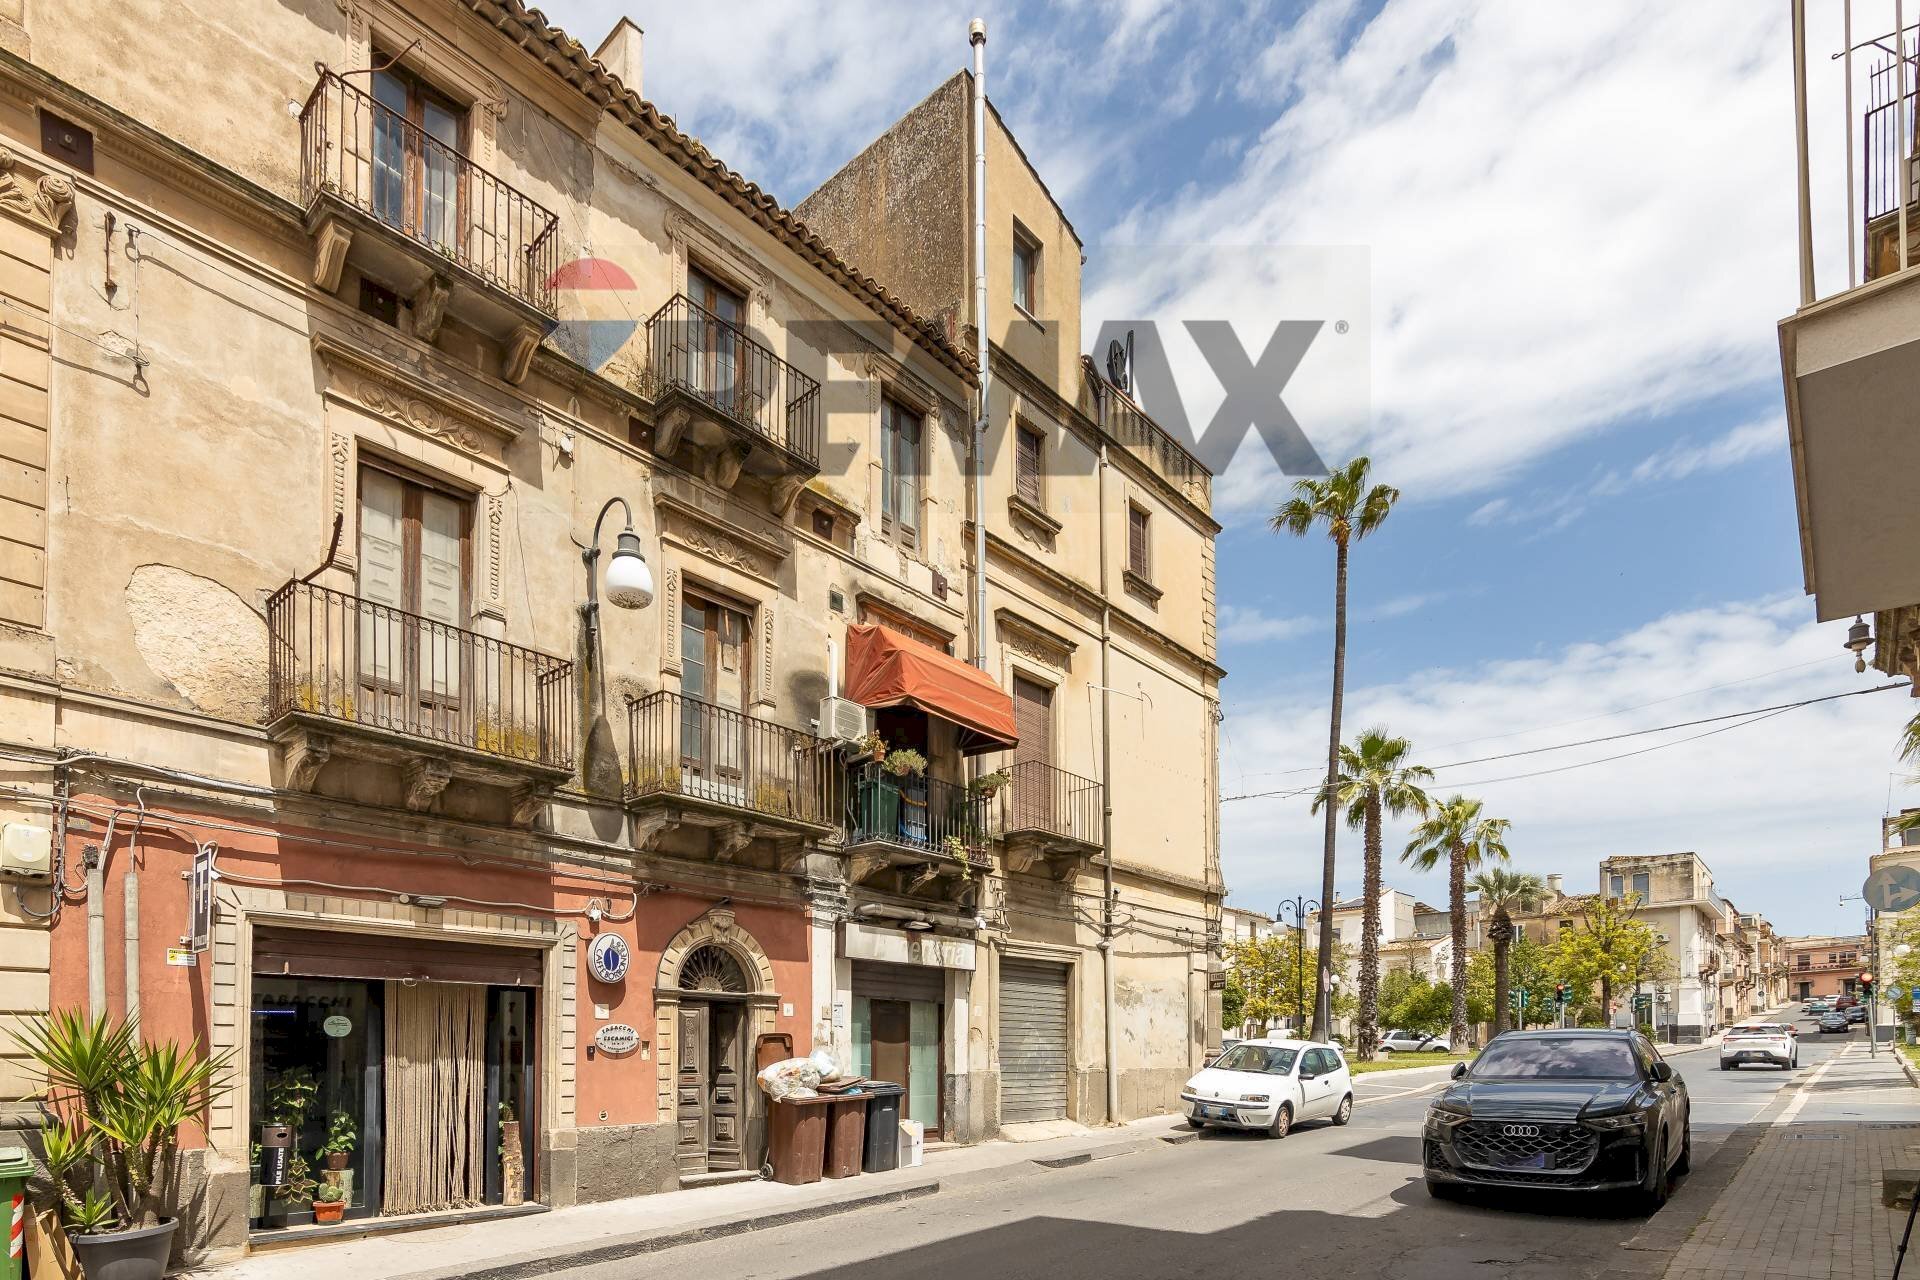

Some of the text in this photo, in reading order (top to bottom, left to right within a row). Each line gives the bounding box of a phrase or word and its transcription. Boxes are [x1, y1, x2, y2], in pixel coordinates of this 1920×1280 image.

[604, 953, 627, 979] BORBONE
[275, 1147, 285, 1185] PILE USATE
